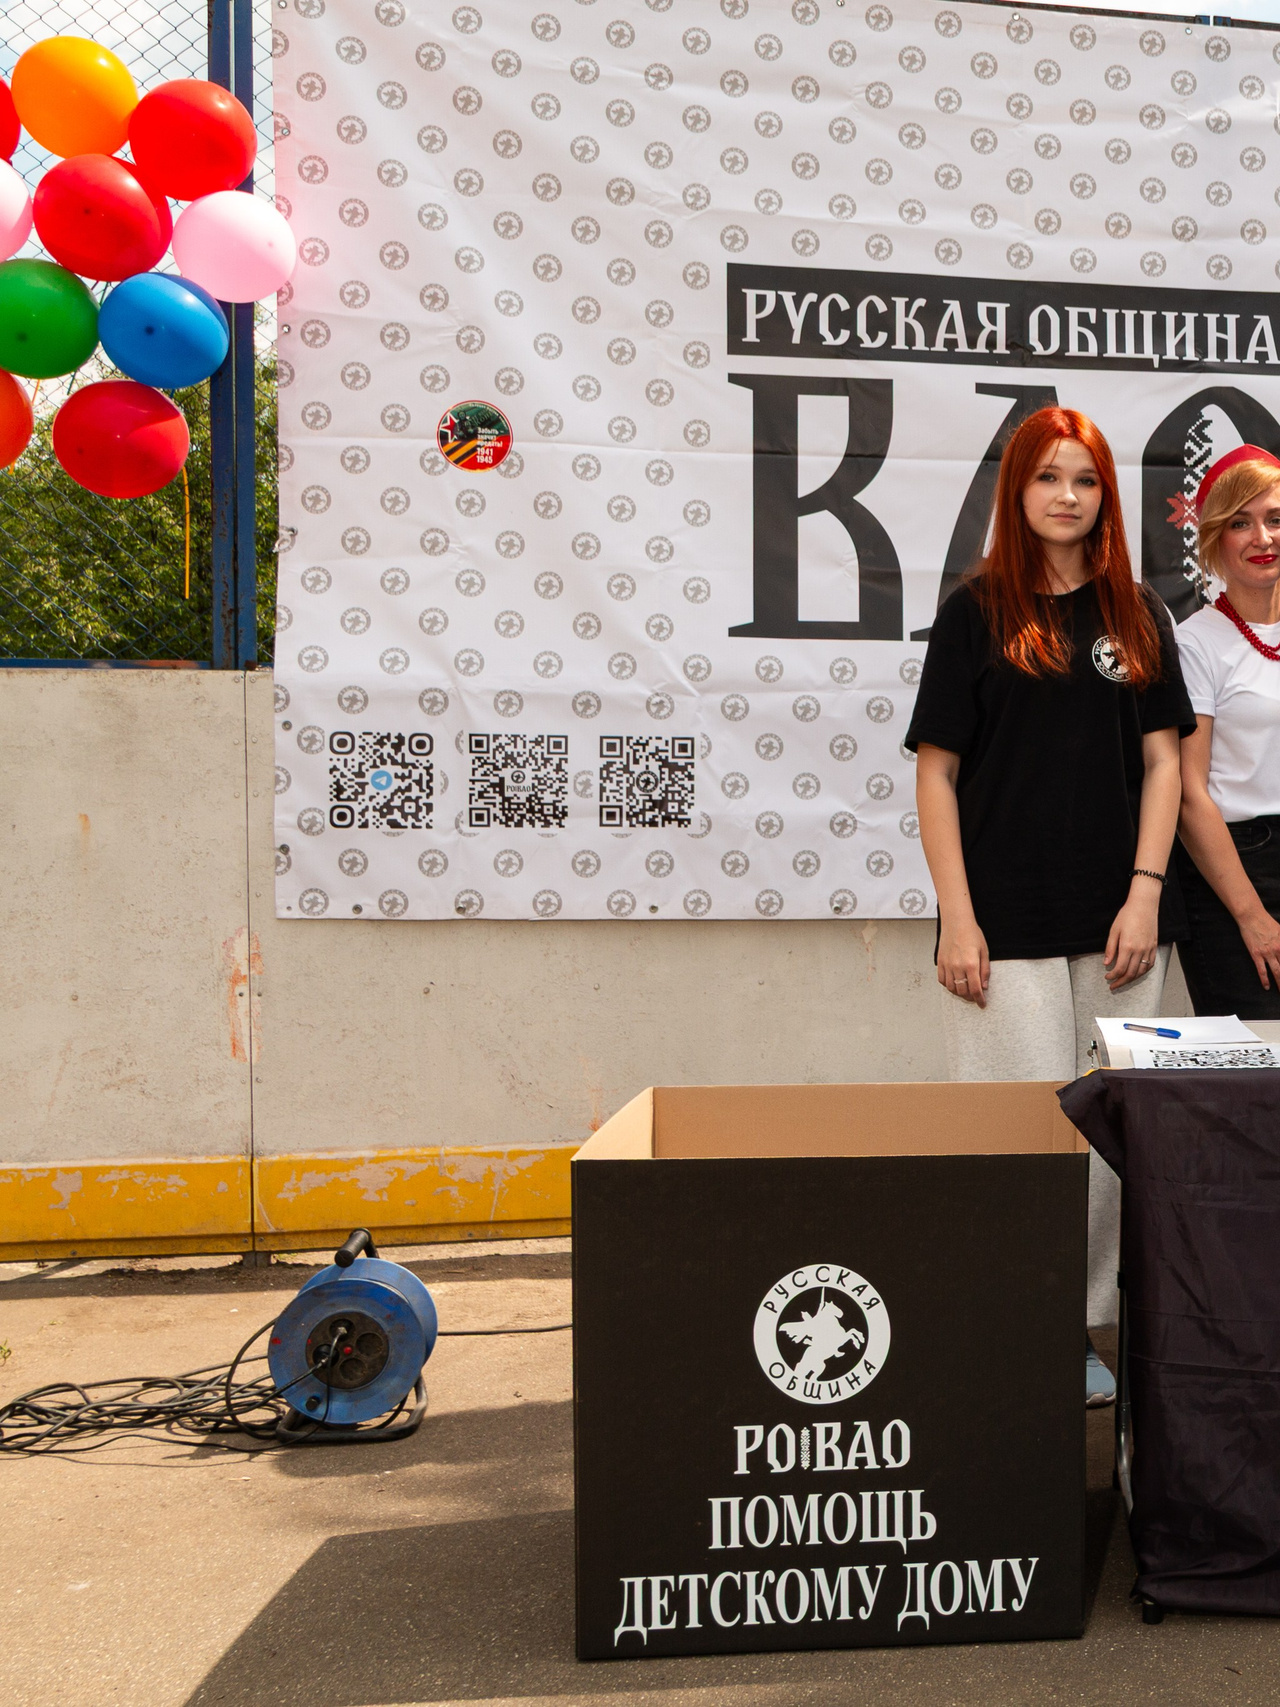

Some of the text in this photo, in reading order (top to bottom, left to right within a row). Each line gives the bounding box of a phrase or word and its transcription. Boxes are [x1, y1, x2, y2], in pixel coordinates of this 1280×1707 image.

[741, 288, 1010, 354] РУССКАЯ
[476, 455, 493, 464] 1945
[477, 448, 493, 456] 1941
[763, 1265, 880, 1314] РУССКАЯ
[768, 1358, 876, 1400] ОБЩИНА
[708, 1489, 937, 1554] ПОМОЩЬ
[614, 1557, 1039, 1647] ДЕТСКОМУ ДОМУ
